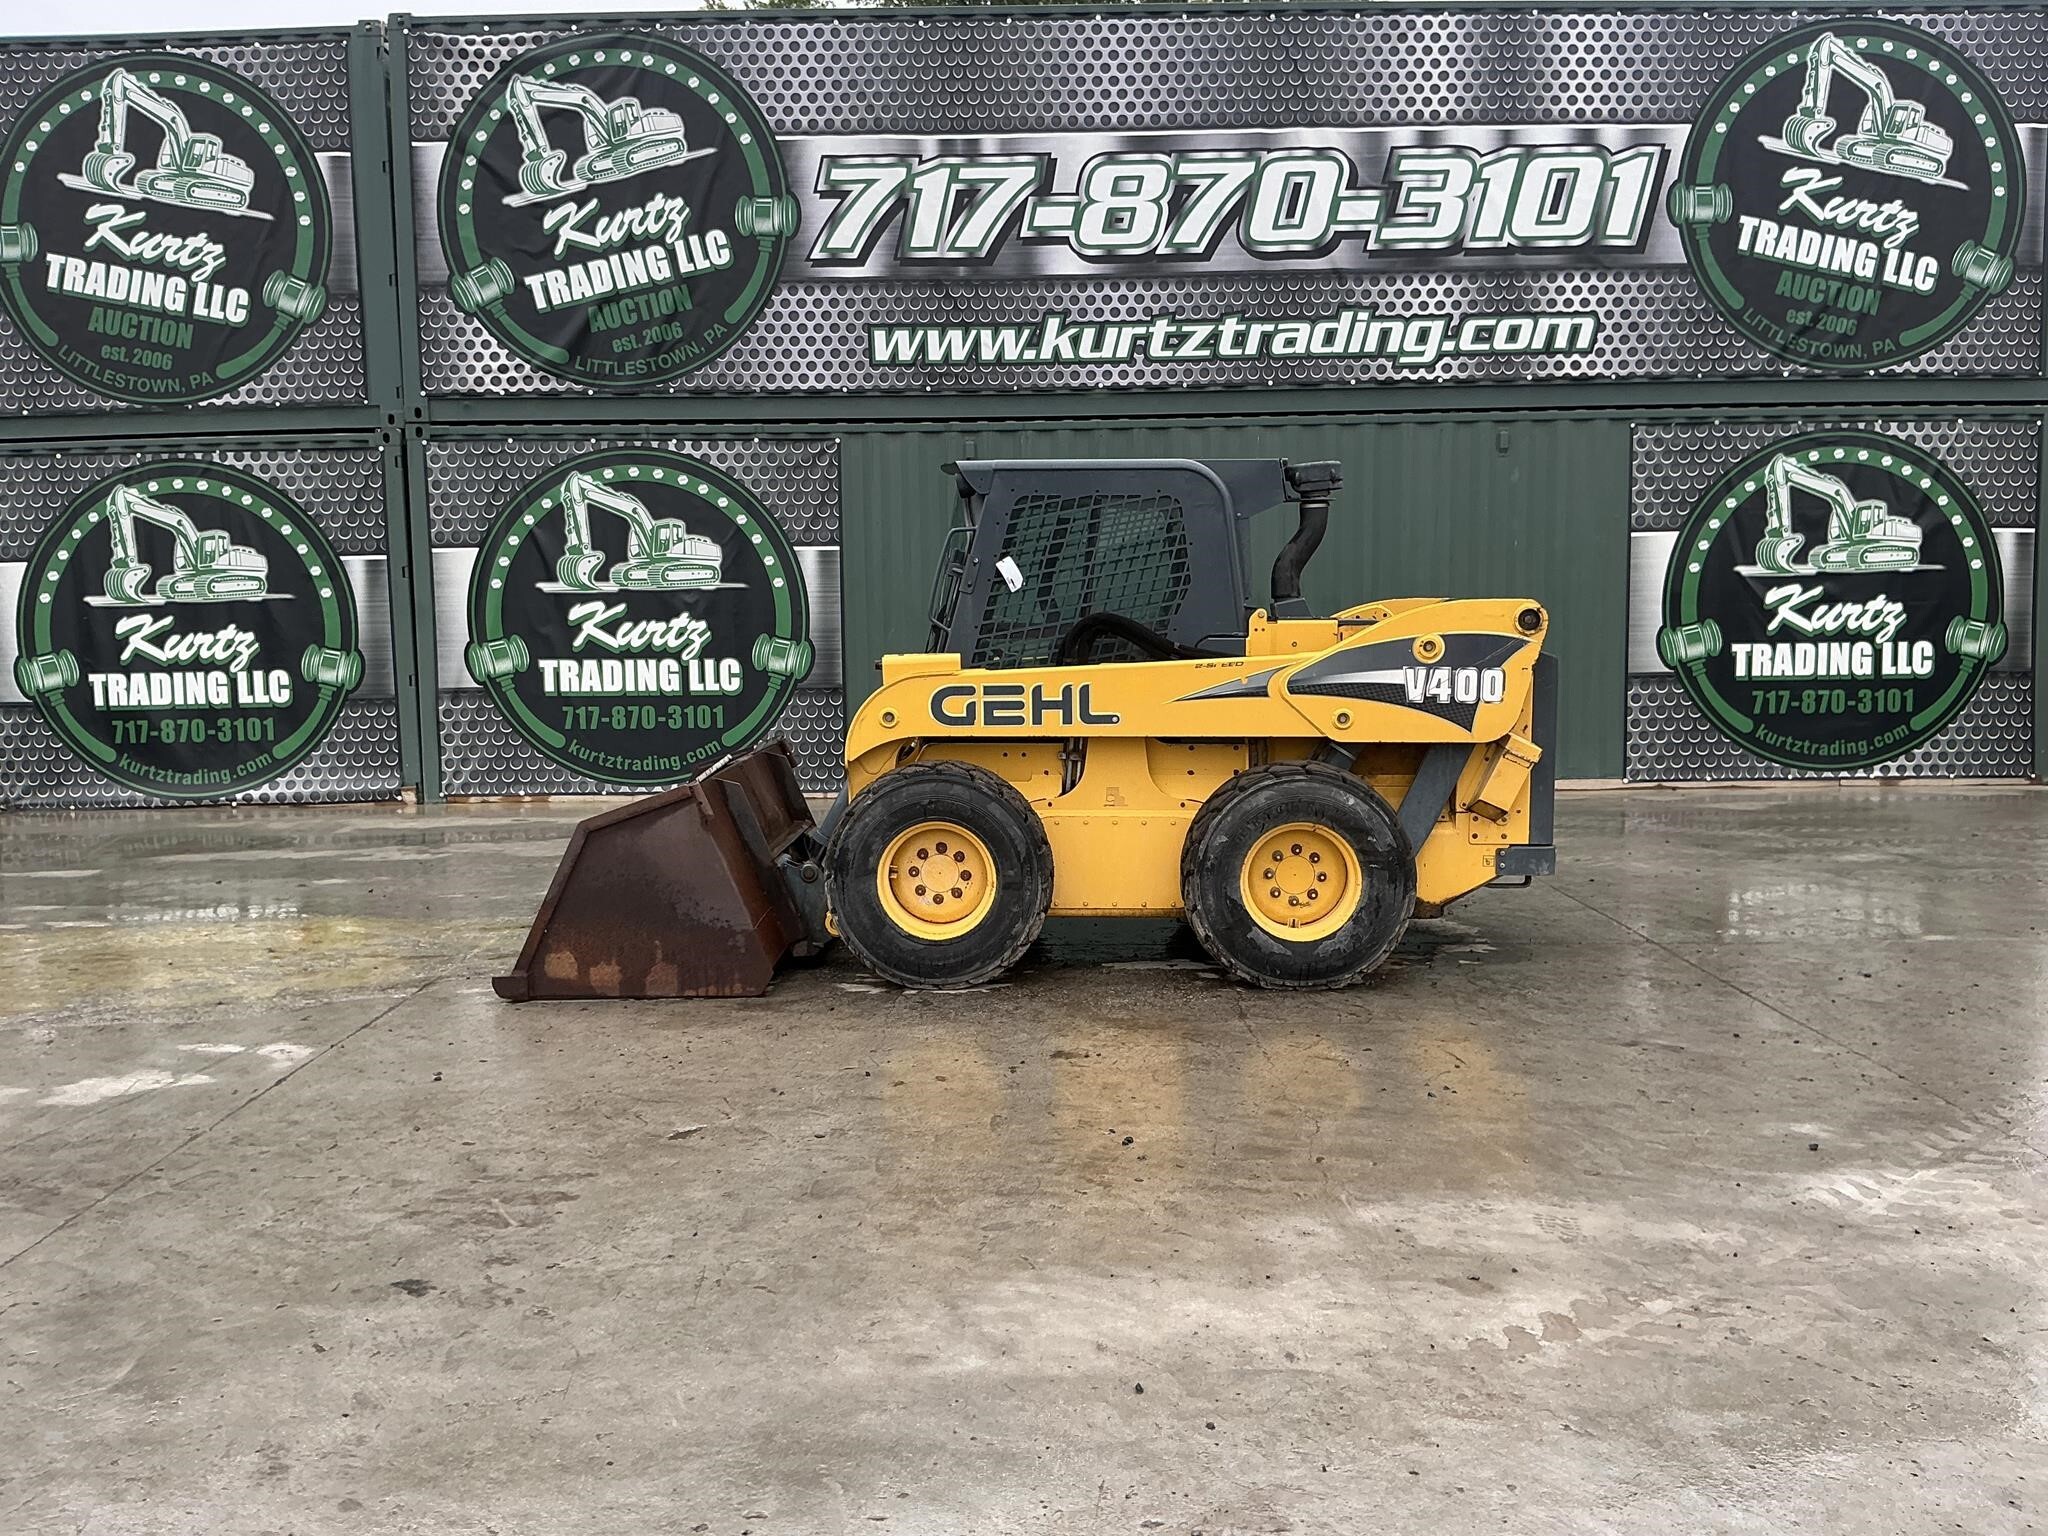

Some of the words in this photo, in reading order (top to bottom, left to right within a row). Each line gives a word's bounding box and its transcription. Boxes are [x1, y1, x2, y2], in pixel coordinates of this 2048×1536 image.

[543, 193, 690, 257] Kurtz
[809, 144, 1671, 265] 717-870-3101
[1778, 167, 1920, 249] Kurtz
[84, 203, 226, 283] Kurtz
[1737, 215, 1879, 280] TRADING
[1883, 248, 1940, 293] LLC
[45, 252, 188, 315] TRADING
[191, 282, 250, 326] LLC
[524, 245, 671, 313] TRADING
[672, 230, 731, 274] LLC
[1775, 270, 1883, 316] AUCTION
[88, 306, 194, 349] AUCTION
[587, 284, 693, 333] AUCTION
[1786, 309, 1813, 328] est.
[1815, 313, 1858, 337] 2006
[574, 343, 706, 376] LITTLESTOWN,
[703, 323, 728, 345] PA
[612, 333, 641, 353] est.
[643, 321, 683, 347] 2006
[870, 310, 1600, 365] www.kurtztrading.com
[1742, 306, 1868, 360] LITTLESTOWN,
[1872, 339, 1897, 355] PA
[58, 344, 186, 394] LITTLESTOWN,
[189, 373, 215, 388] PA
[101, 345, 129, 365] est.
[132, 348, 173, 371] 2006
[567, 601, 711, 661] Kurtz
[1764, 583, 1907, 643] Kurtz
[115, 614, 260, 674] Kurtz
[1731, 642, 1874, 680] TRADING
[1881, 640, 1935, 680] LLC
[88, 671, 231, 710] TRADING
[237, 670, 293, 708] LLC
[538, 659, 681, 696] TRADING
[688, 658, 743, 696] LLC
[1402, 665, 1506, 704] V400
[561, 704, 725, 731] 717-870-3101
[929, 682, 1121, 727] GEHL
[1751, 688, 1914, 715] 717-870-3101
[111, 717, 277, 744] 717-870-3101
[1755, 723, 1910, 757] kurtztrading.com
[118, 753, 273, 786] kurtztrading.com
[568, 738, 722, 772] kurtztrading.com
